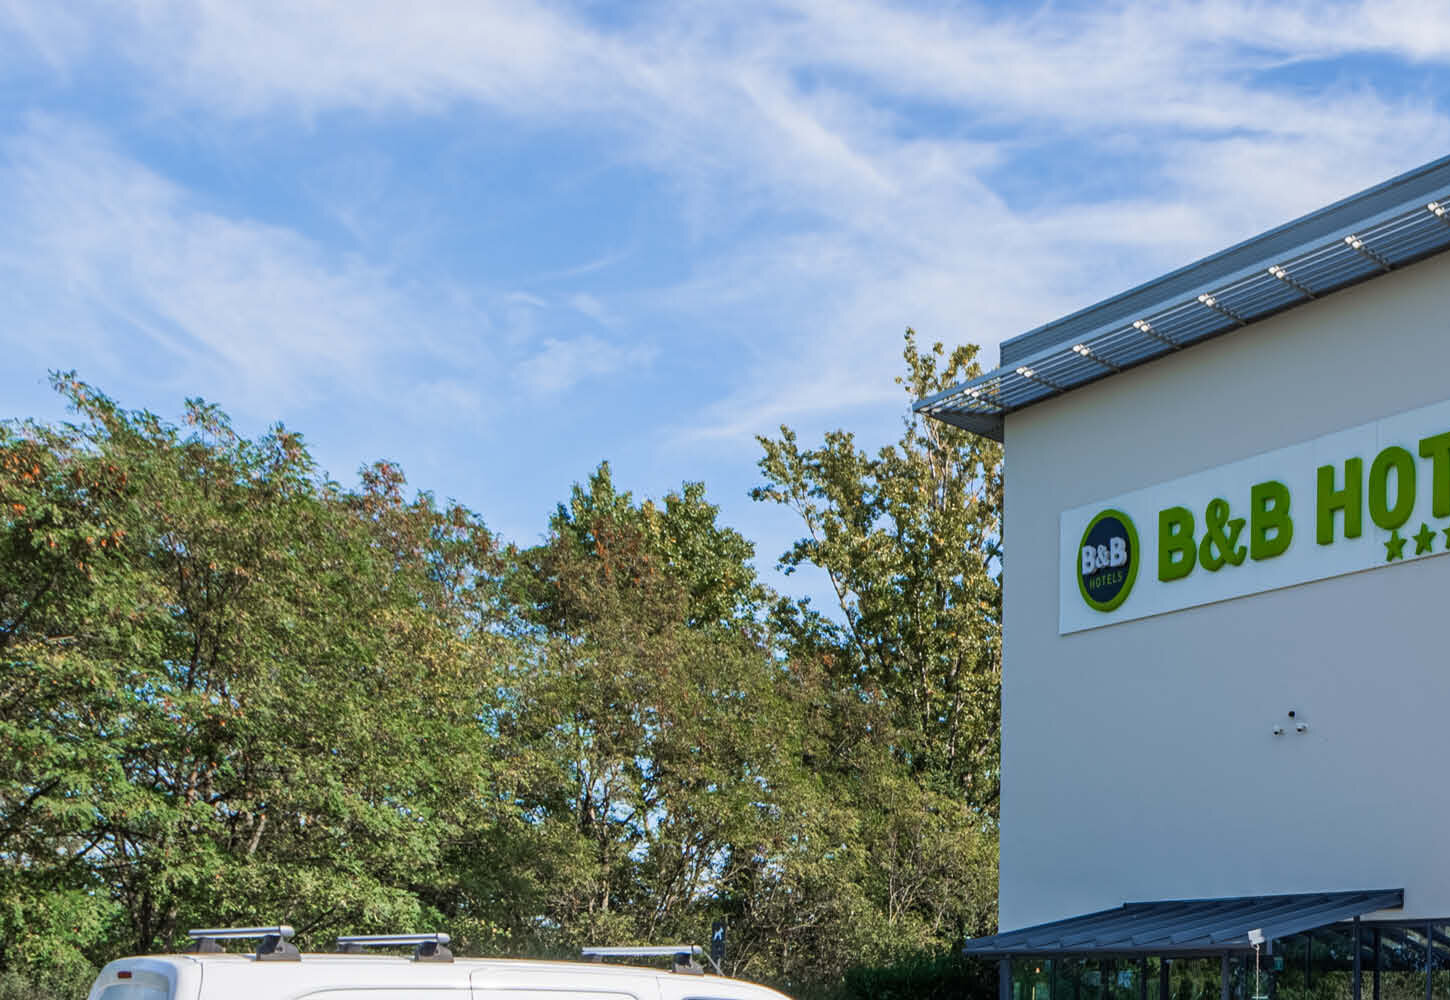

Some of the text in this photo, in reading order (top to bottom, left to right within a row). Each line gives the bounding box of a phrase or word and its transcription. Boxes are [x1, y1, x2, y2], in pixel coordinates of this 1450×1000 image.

[1158, 480, 1293, 583] B&B
[1082, 537, 1127, 575] B&B
[1090, 571, 1122, 592] HOTELS
